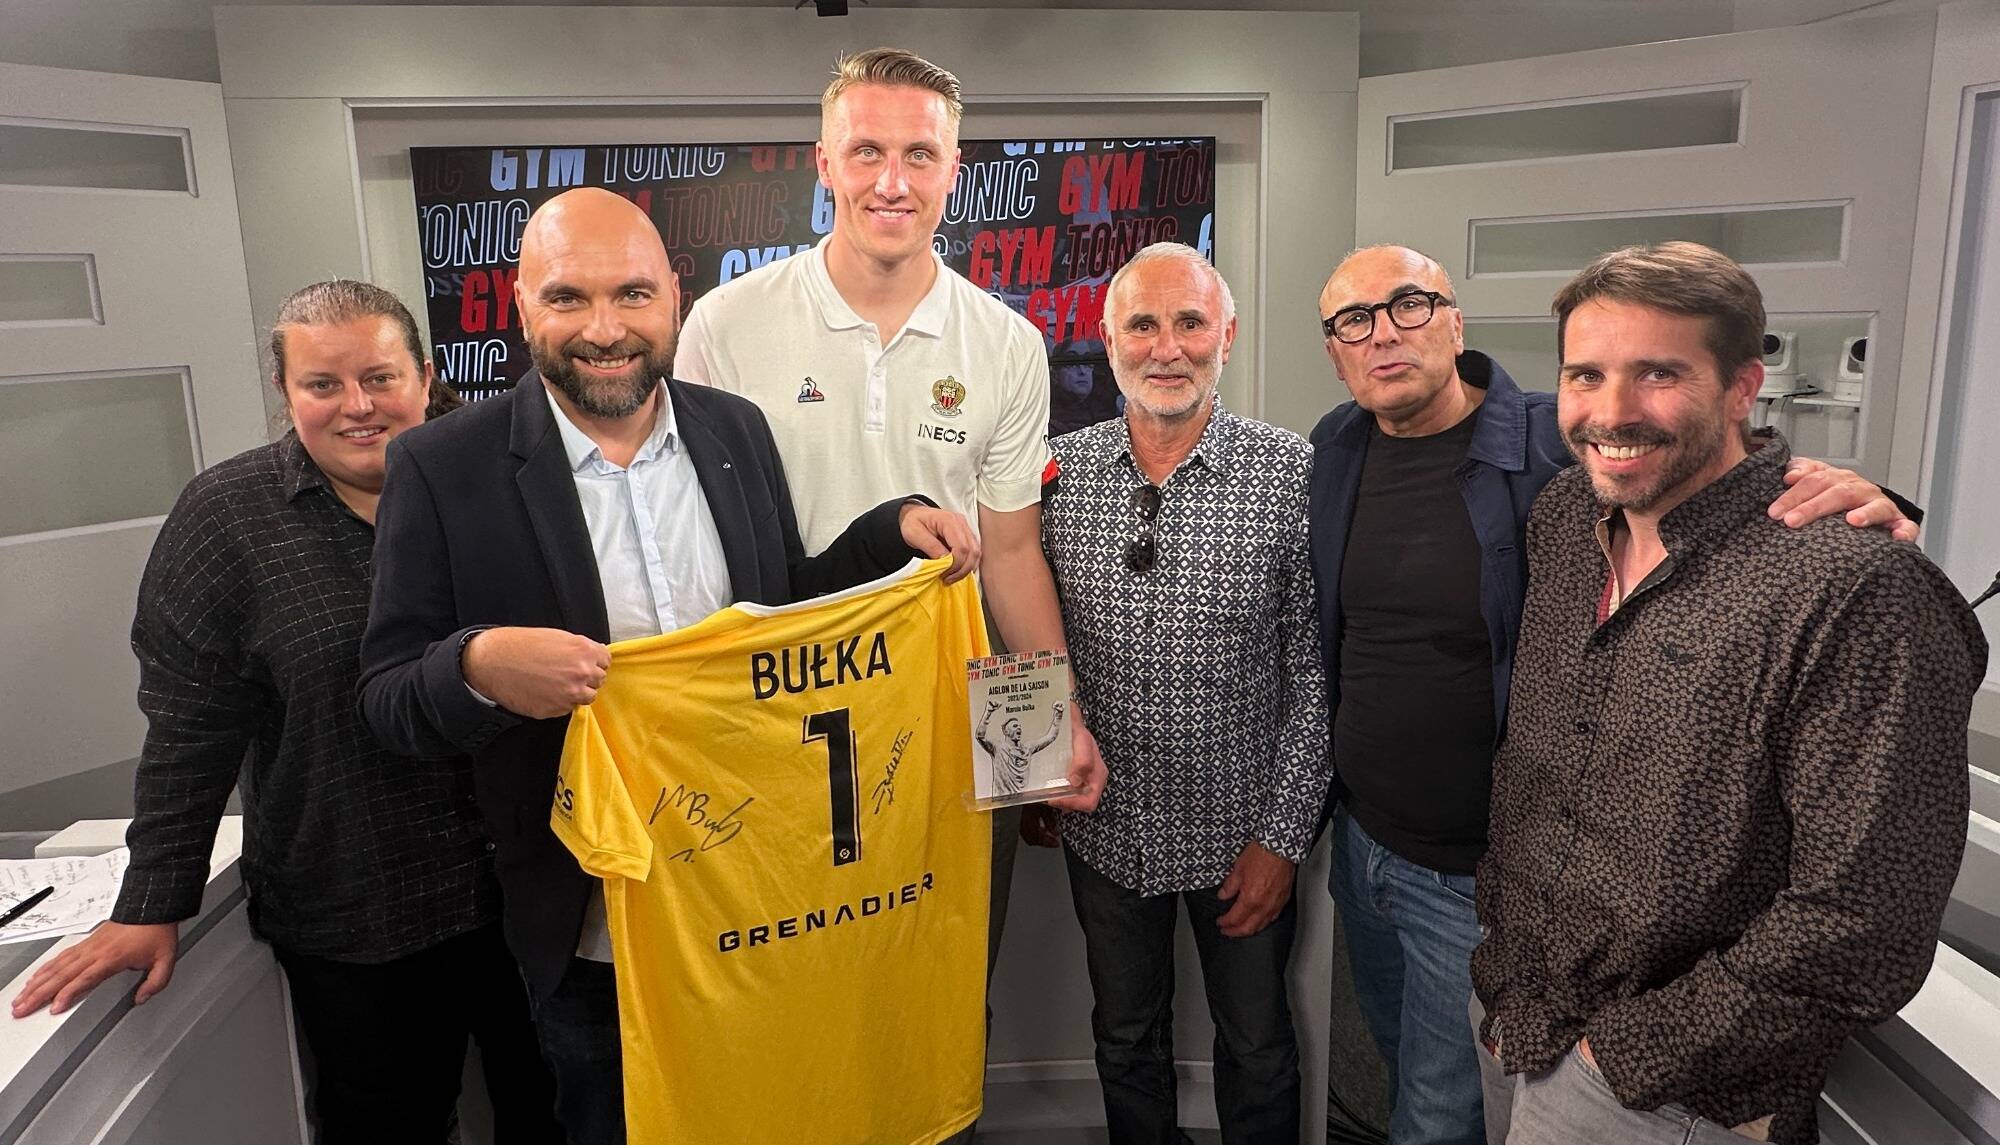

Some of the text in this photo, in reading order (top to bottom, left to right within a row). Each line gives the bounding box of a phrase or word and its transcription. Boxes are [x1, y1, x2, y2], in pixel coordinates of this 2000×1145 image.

[490, 149, 586, 191] GYM
[943, 159, 1039, 225] ONIC
[1058, 150, 1146, 216] GYM
[421, 198, 530, 269] ONIC
[664, 180, 789, 249] TONIC
[969, 225, 1056, 289] GYM
[461, 268, 523, 334] GY
[1027, 283, 1109, 344] GYM
[917, 423, 967, 445] INEOS
[751, 631, 892, 700] BUŁKA
[988, 680, 1050, 695] AIGLON DE LA SAISON
[802, 706, 862, 867] 1
[718, 871, 935, 953] GRENADIER
